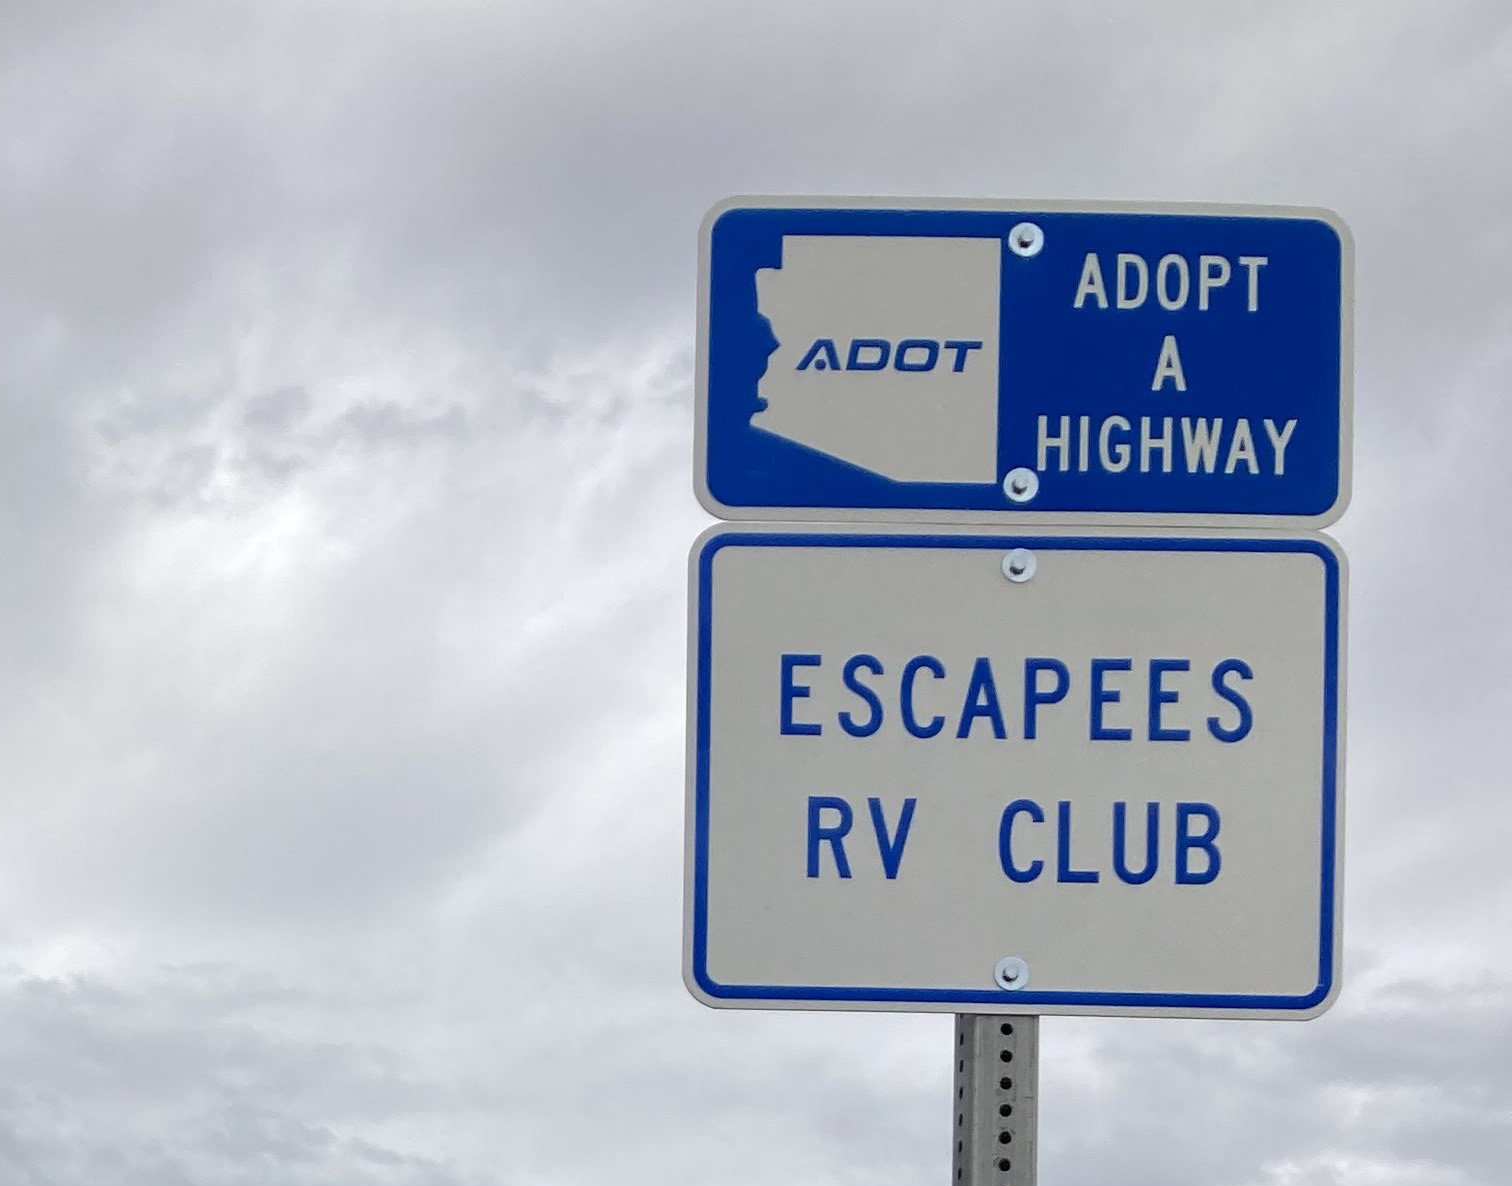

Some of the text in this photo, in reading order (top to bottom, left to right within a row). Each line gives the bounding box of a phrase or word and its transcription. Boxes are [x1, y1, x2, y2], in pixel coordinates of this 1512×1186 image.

[1073, 253, 1269, 311] ADOPT
[795, 339, 982, 373] ADOT
[1151, 335, 1187, 392] A
[1037, 415, 1297, 475] HIGHWAY
[780, 653, 1254, 743] ESCAPEES
[806, 796, 1222, 885] RV CLUB
